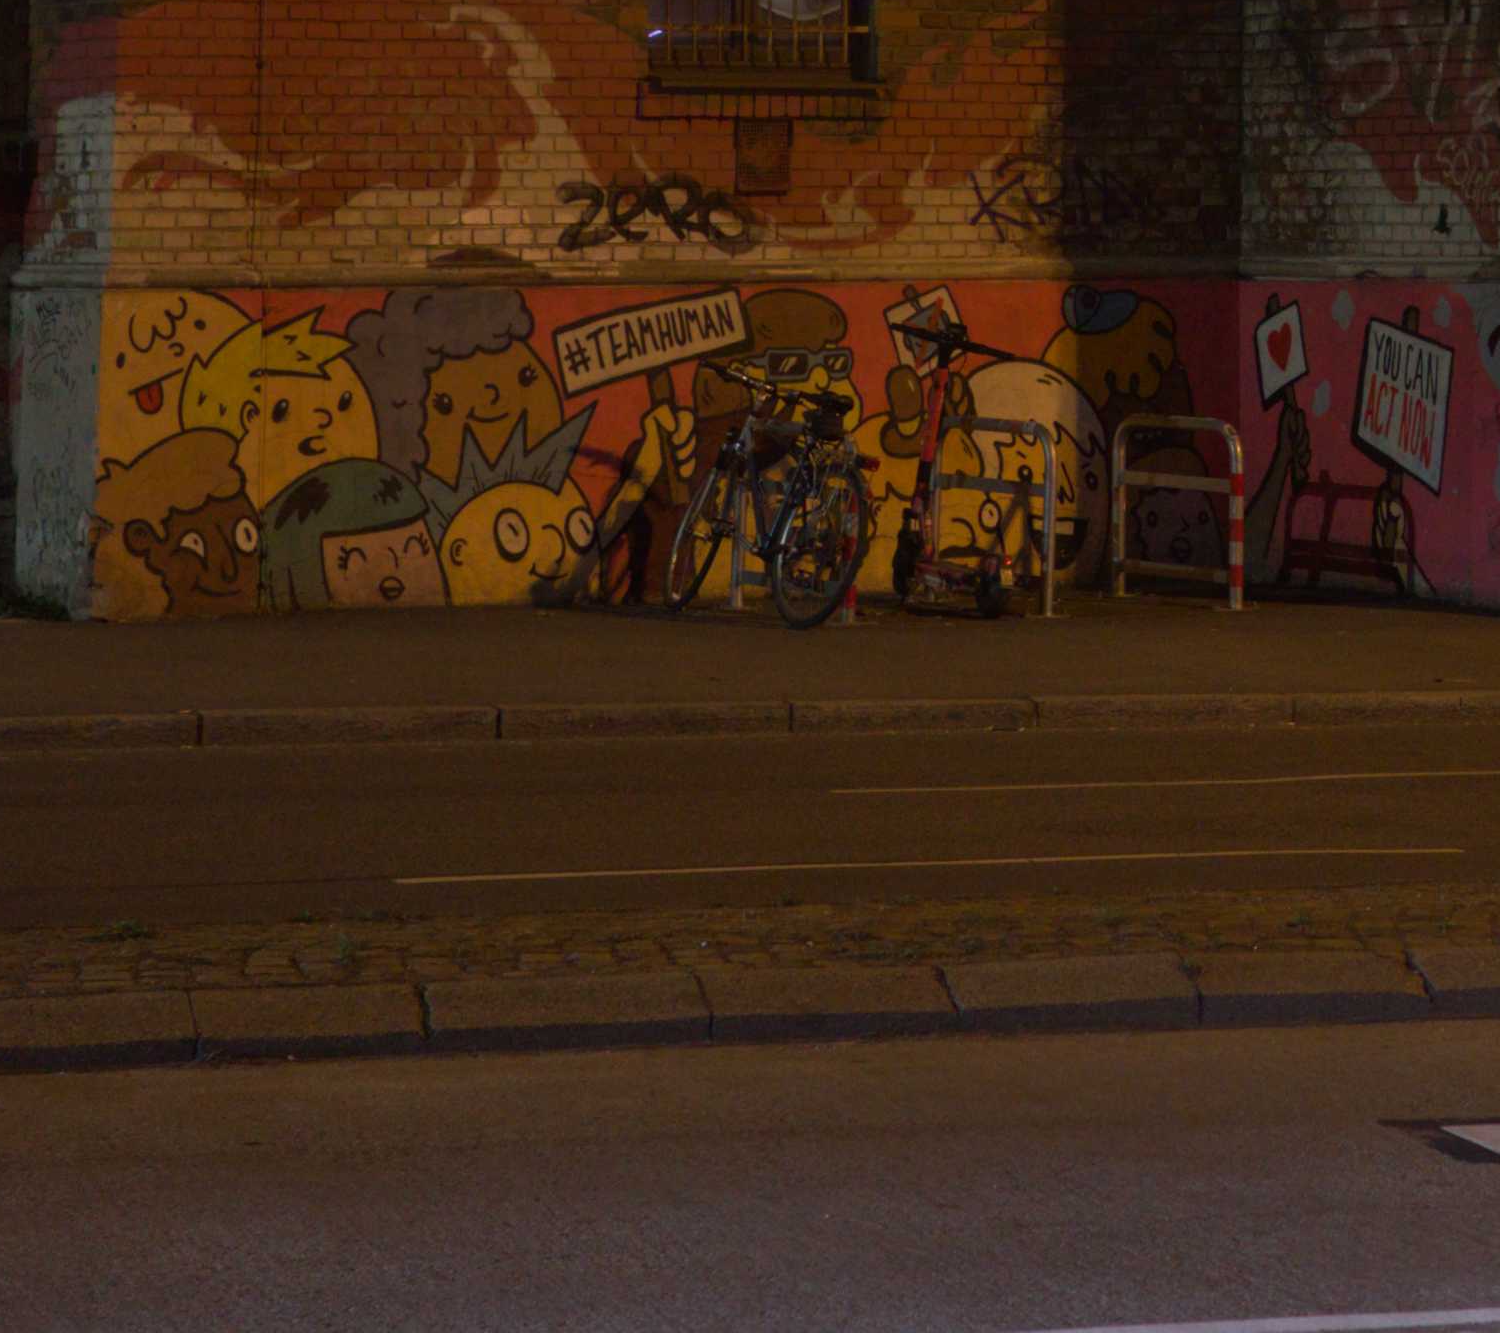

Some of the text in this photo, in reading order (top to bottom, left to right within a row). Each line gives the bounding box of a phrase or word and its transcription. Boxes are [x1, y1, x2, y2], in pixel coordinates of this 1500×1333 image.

[563, 301, 736, 375] #TEAMHUMAN
[1374, 332, 1402, 381] YOU
[1404, 344, 1440, 402] CAN
[1363, 373, 1437, 470] ACT NOW
